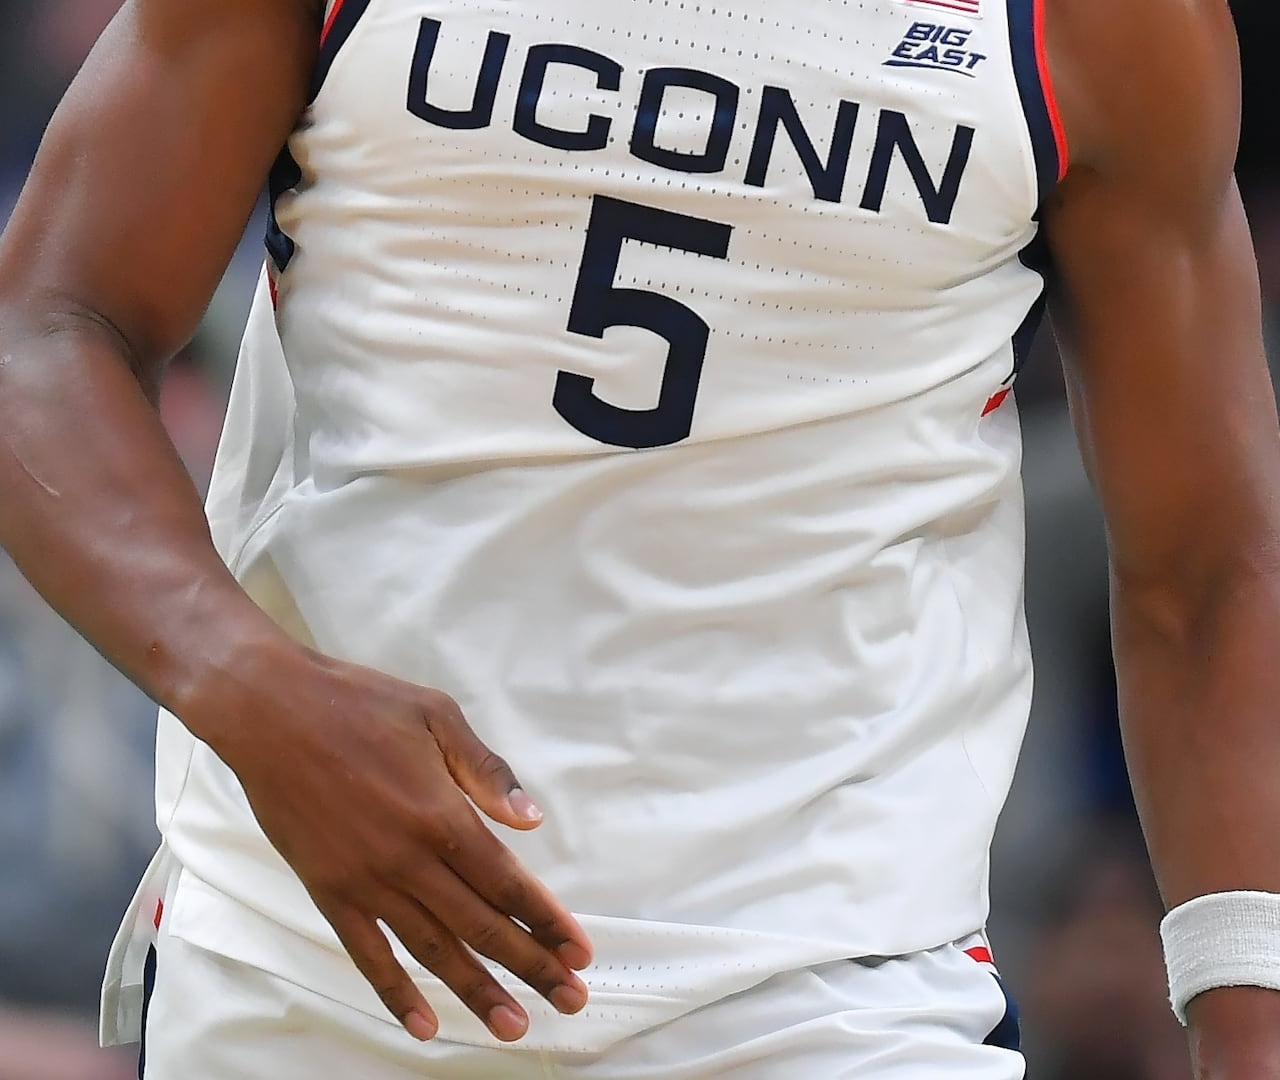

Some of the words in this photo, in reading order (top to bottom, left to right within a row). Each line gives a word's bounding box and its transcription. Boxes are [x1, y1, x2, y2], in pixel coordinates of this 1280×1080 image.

[891, 40, 987, 70] EAST
[903, 21, 973, 47] BIG
[406, 16, 975, 226] UCONN
[552, 193, 734, 450] 5
